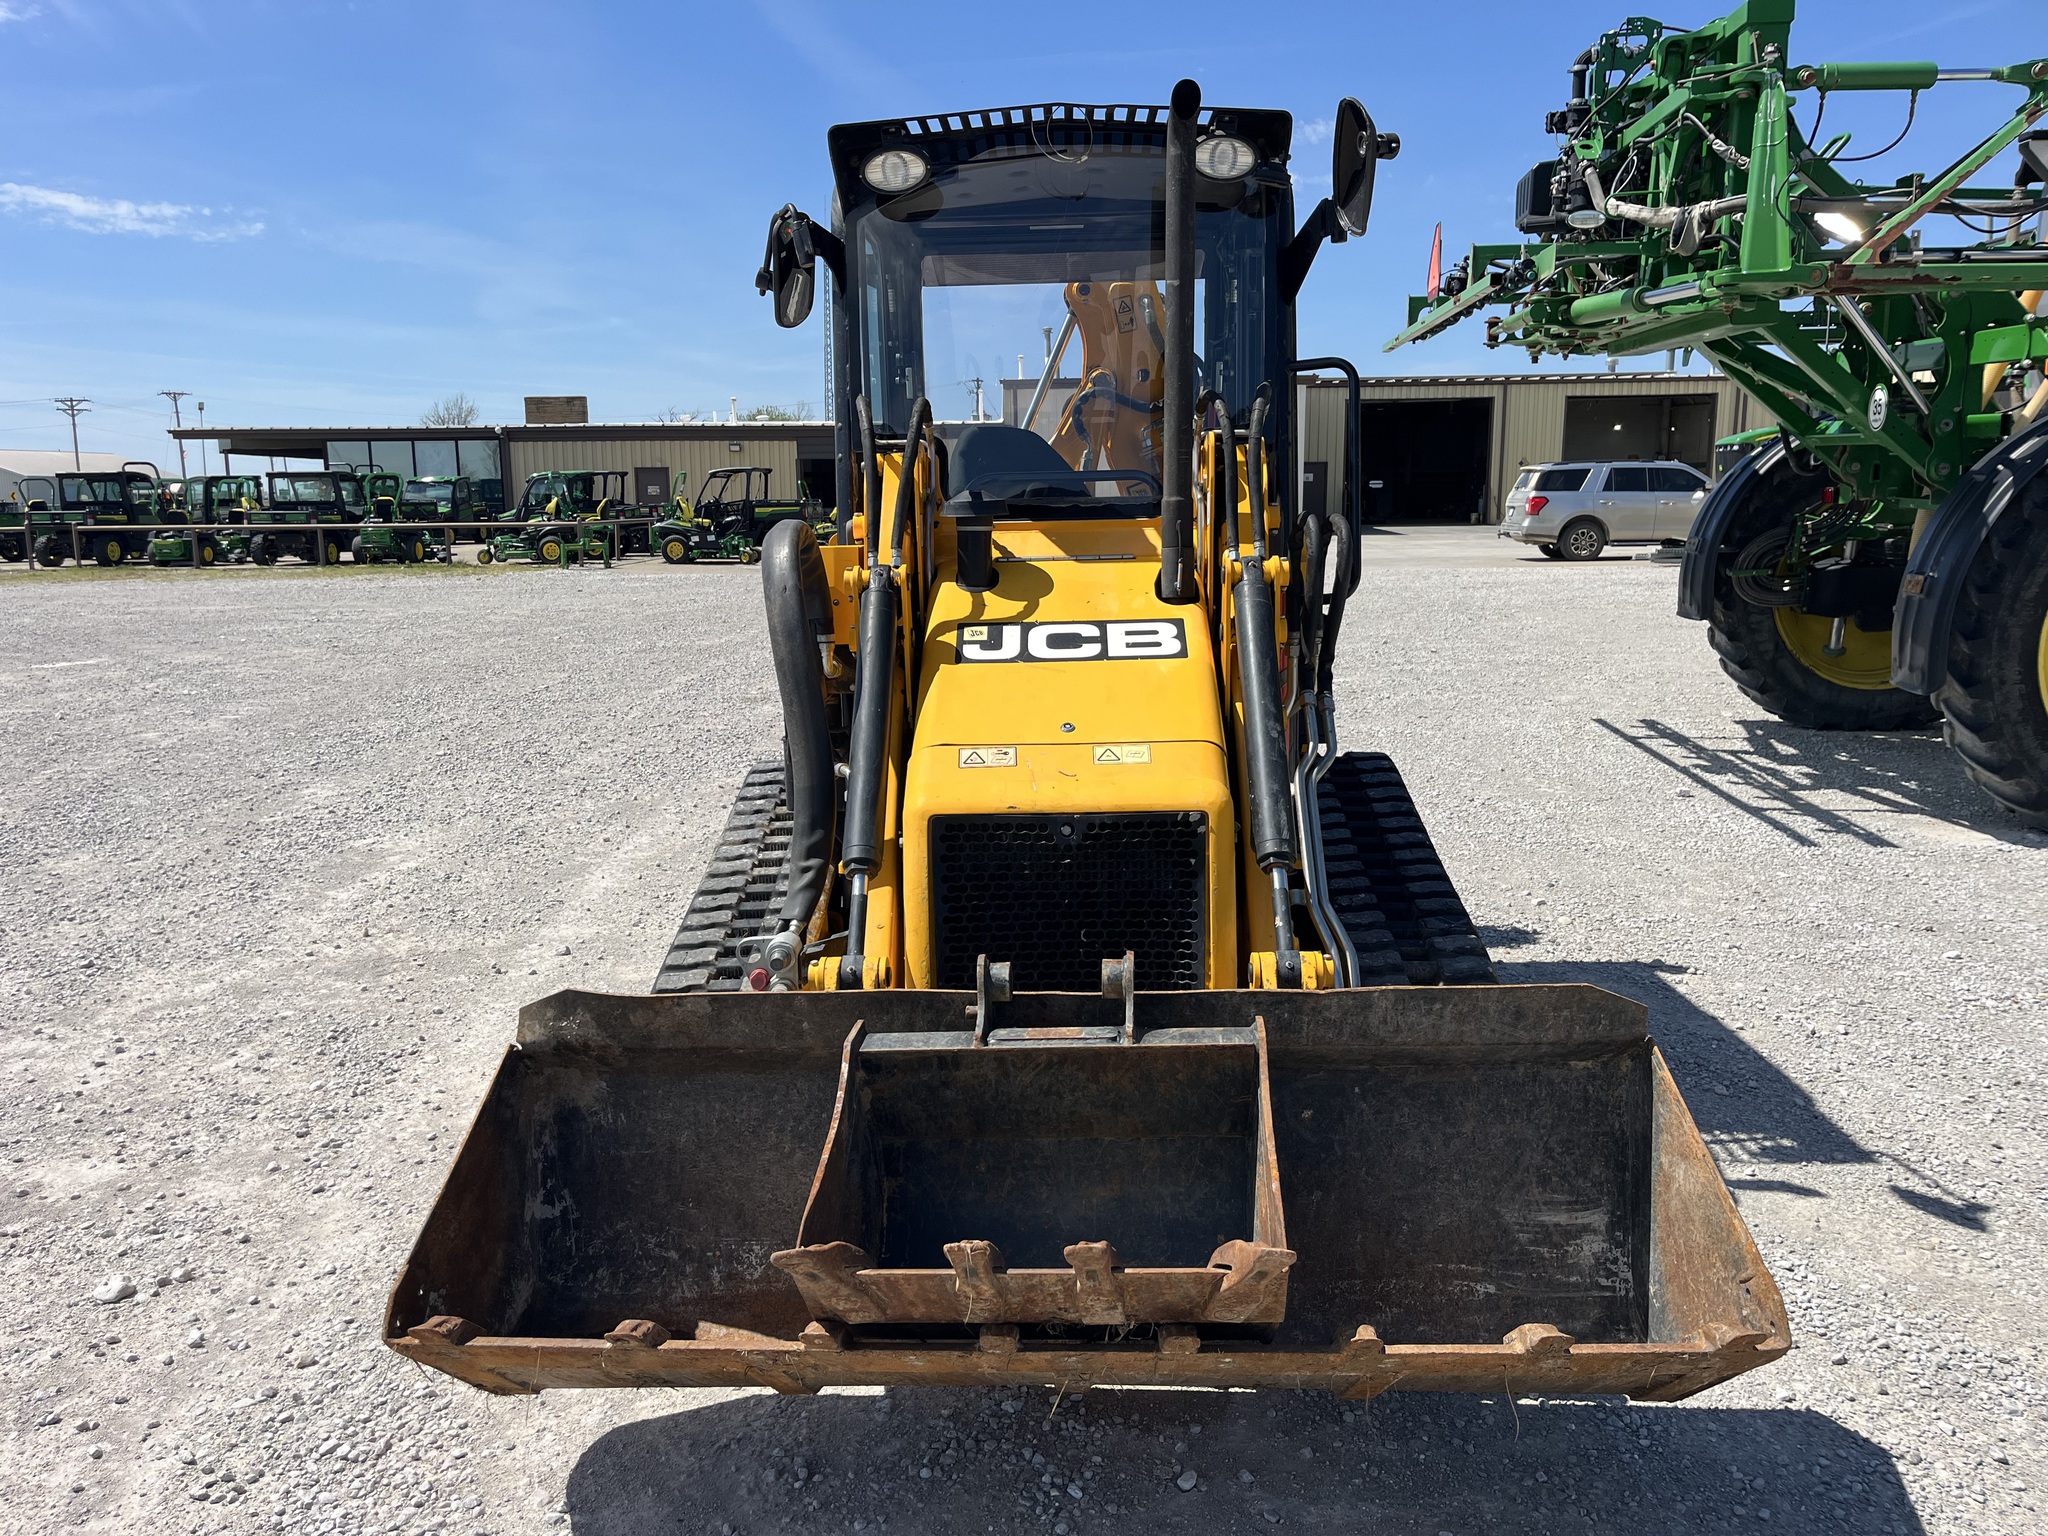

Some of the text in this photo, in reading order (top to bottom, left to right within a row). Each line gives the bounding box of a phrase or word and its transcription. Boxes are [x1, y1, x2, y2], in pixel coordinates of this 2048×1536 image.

[1873, 398, 1882, 416] 35
[962, 622, 1181, 660] JCB
[969, 629, 984, 638] JCB
